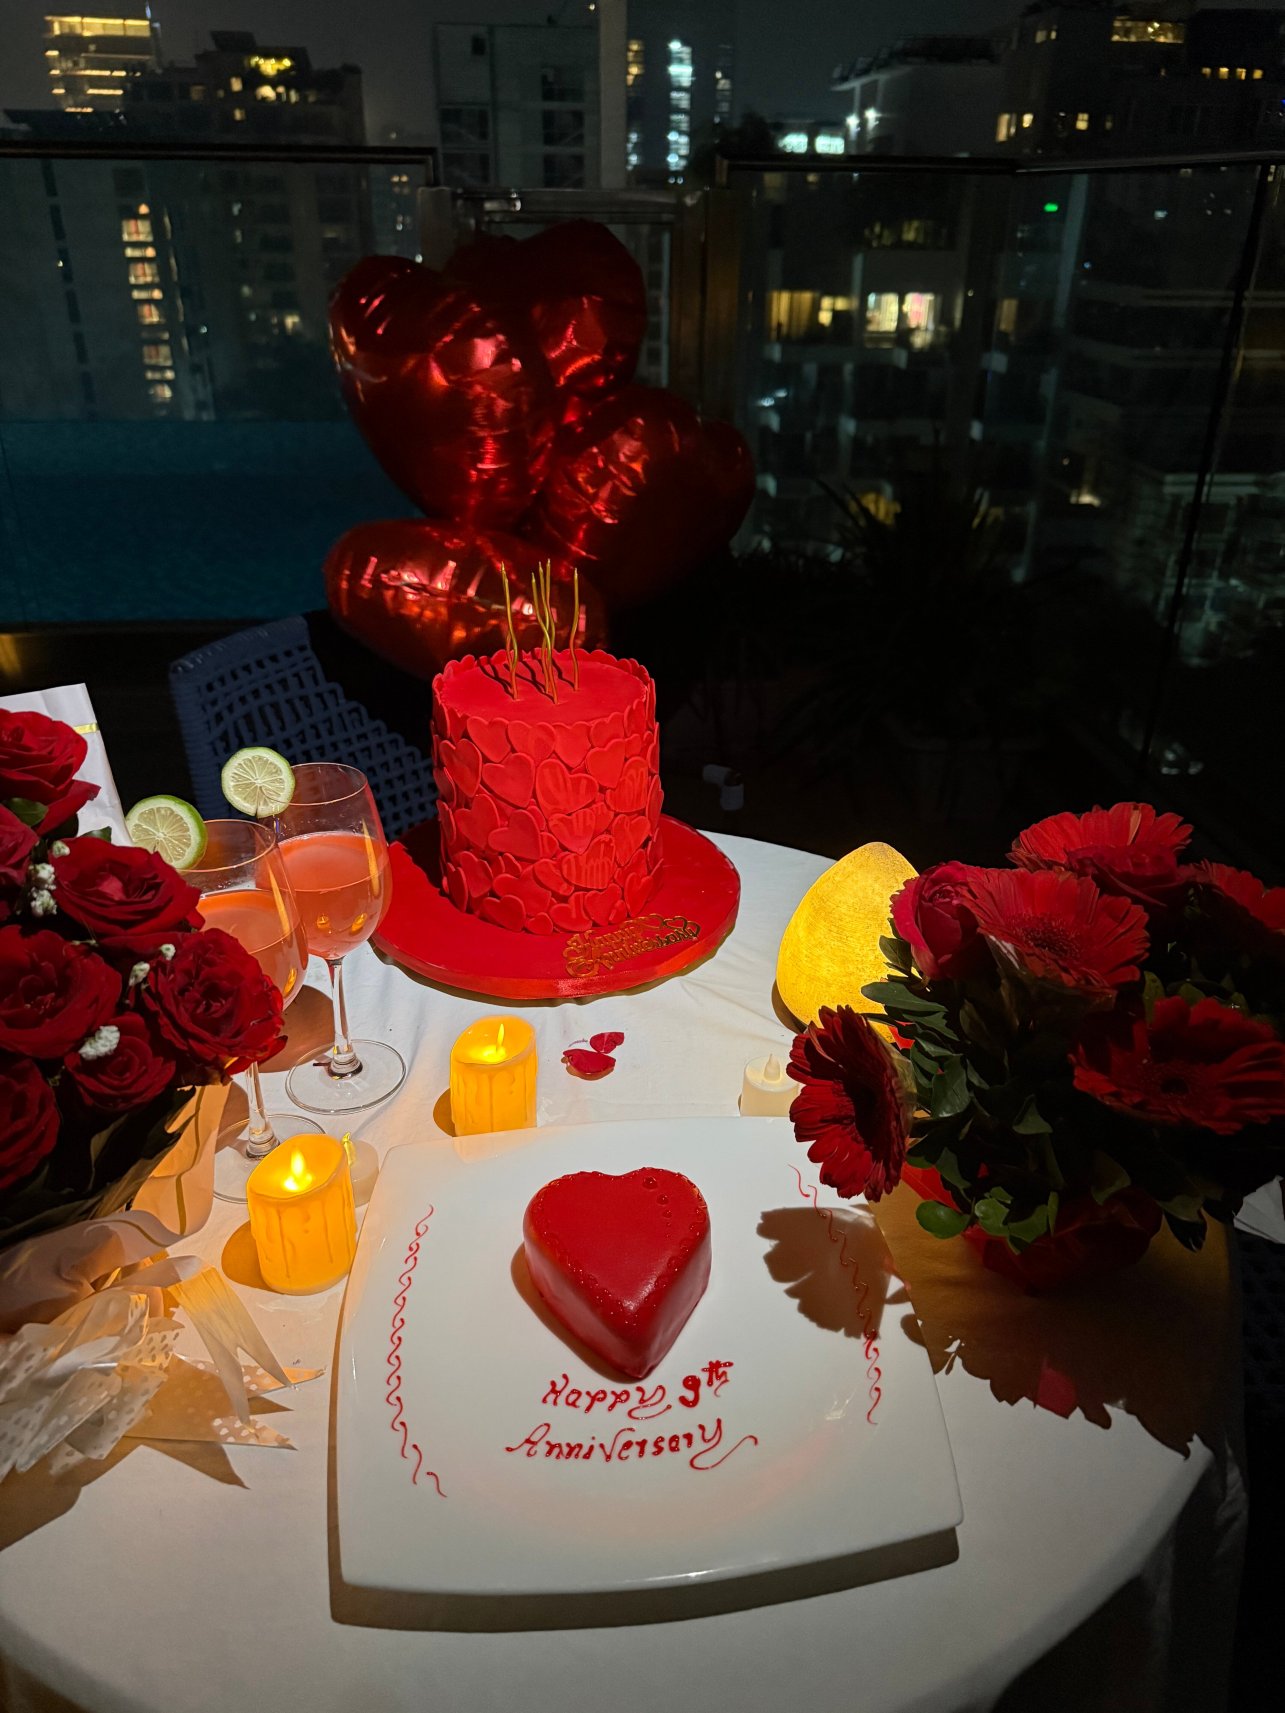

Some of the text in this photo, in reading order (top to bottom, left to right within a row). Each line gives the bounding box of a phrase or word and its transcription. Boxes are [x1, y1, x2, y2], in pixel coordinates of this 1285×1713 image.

[542, 1360, 734, 1420] Happy 9th
[505, 1418, 758, 1470] Anniversary
